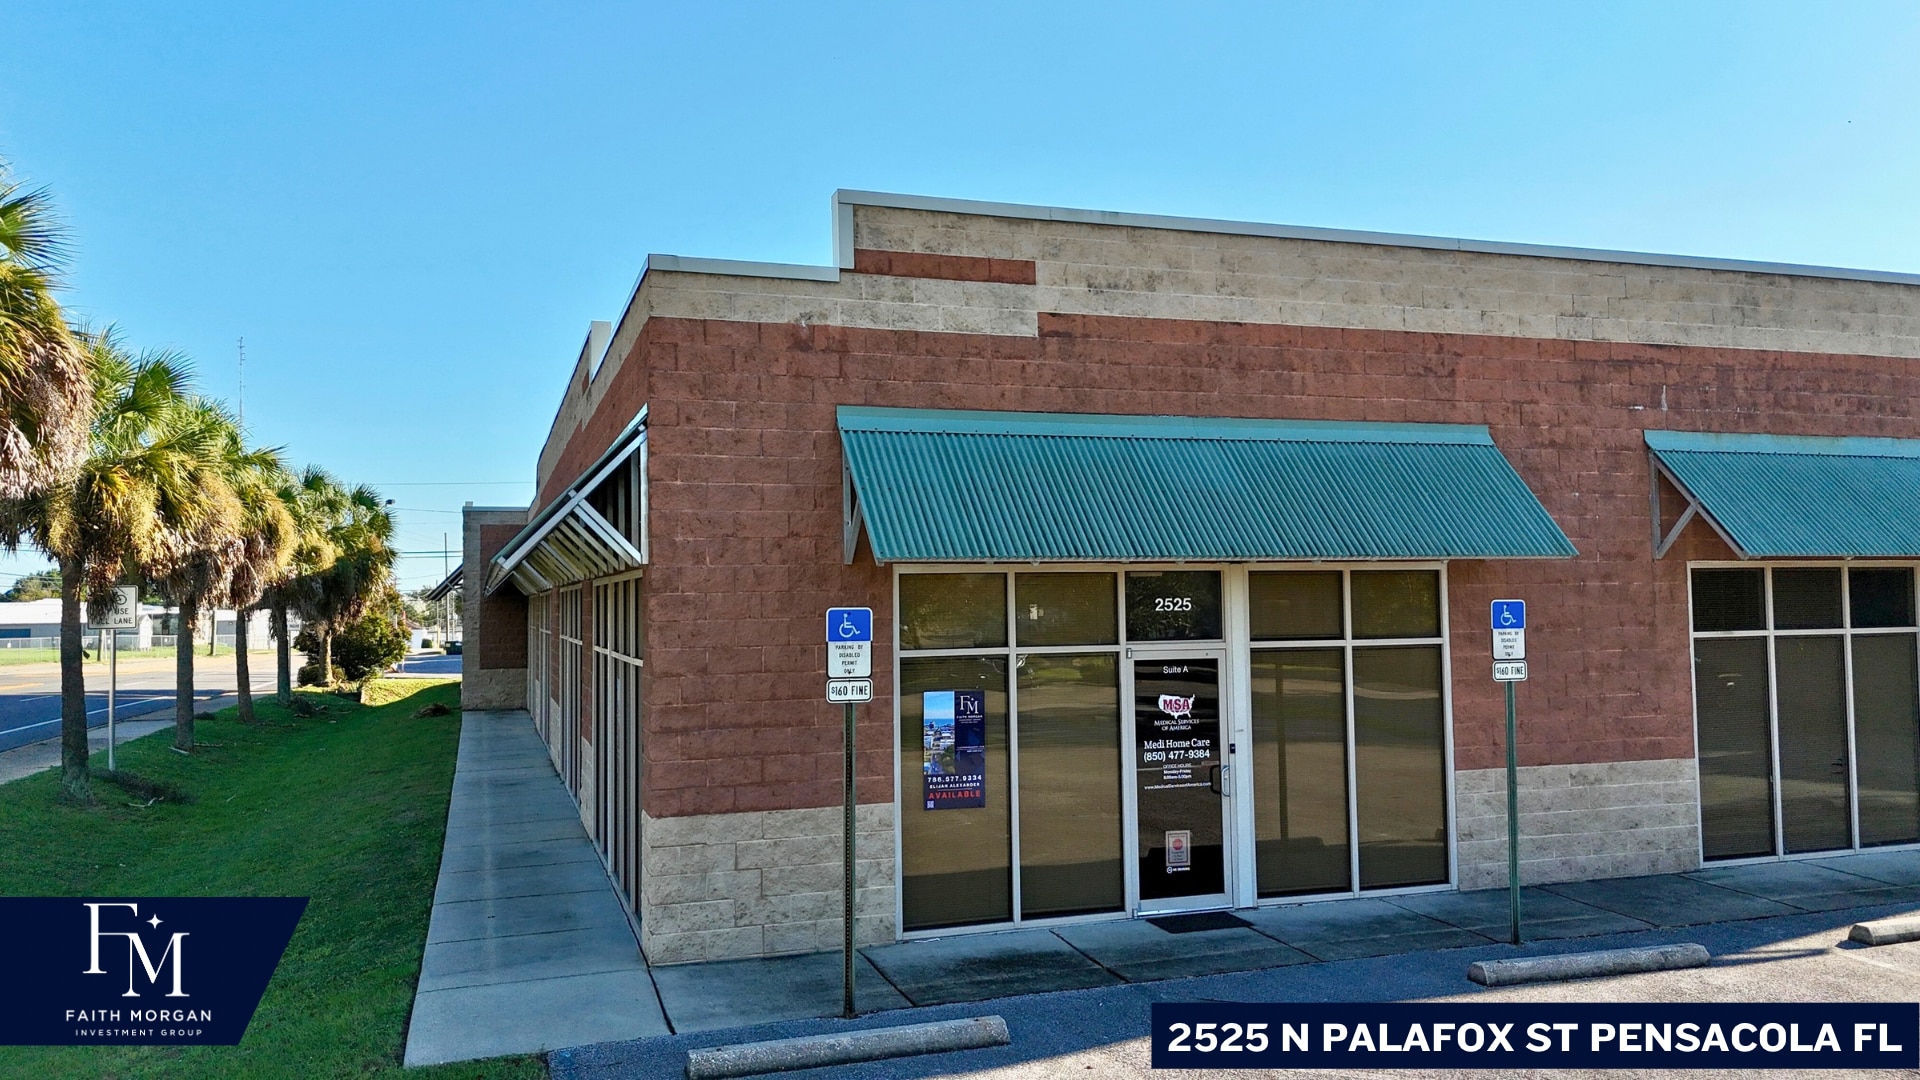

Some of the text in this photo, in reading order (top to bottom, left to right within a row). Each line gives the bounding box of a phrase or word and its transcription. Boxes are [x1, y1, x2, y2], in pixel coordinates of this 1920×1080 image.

[1155, 598, 1192, 611] 2525
[114, 617, 133, 625] LANE
[1163, 665, 1189, 674] Suite A
[1497, 666, 1524, 676] $160 FINE
[831, 685, 868, 696] $160 FINE
[1163, 698, 1190, 712] MSA
[1144, 738, 1210, 749] Medi Home Care
[1144, 749, 1210, 763] (850) 477-9384
[928, 790, 981, 799] AVAILABLE
